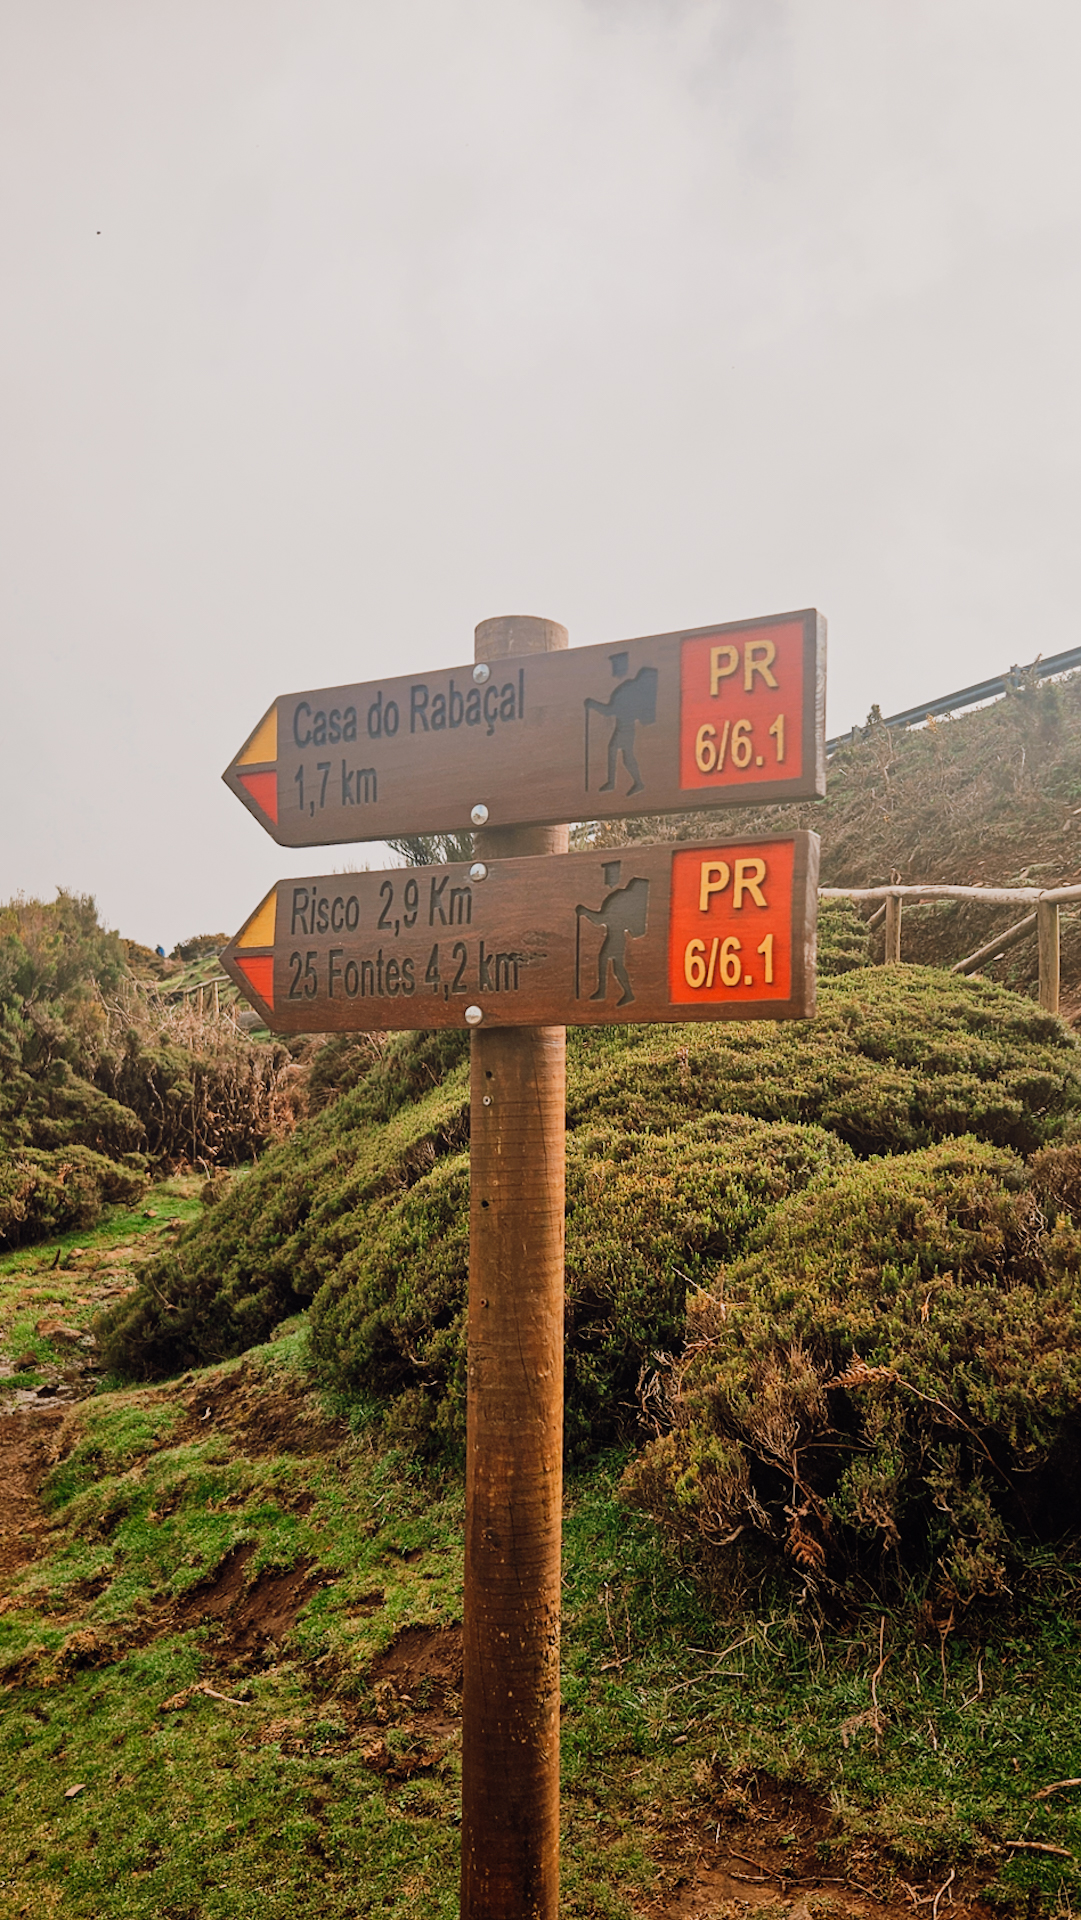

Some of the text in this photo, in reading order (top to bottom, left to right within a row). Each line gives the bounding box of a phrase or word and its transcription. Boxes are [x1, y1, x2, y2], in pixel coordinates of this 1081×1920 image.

[710, 640, 779, 696] PR
[293, 668, 524, 748] Casa do Rabaçal
[695, 714, 785, 772] 6/6.1
[294, 759, 377, 817] 1,7 km
[291, 876, 472, 937] Risco 2,9 Km
[699, 858, 768, 911] PR
[289, 941, 519, 1001] 25 Fontes 4,2 km
[684, 933, 773, 988] 6/6.1
